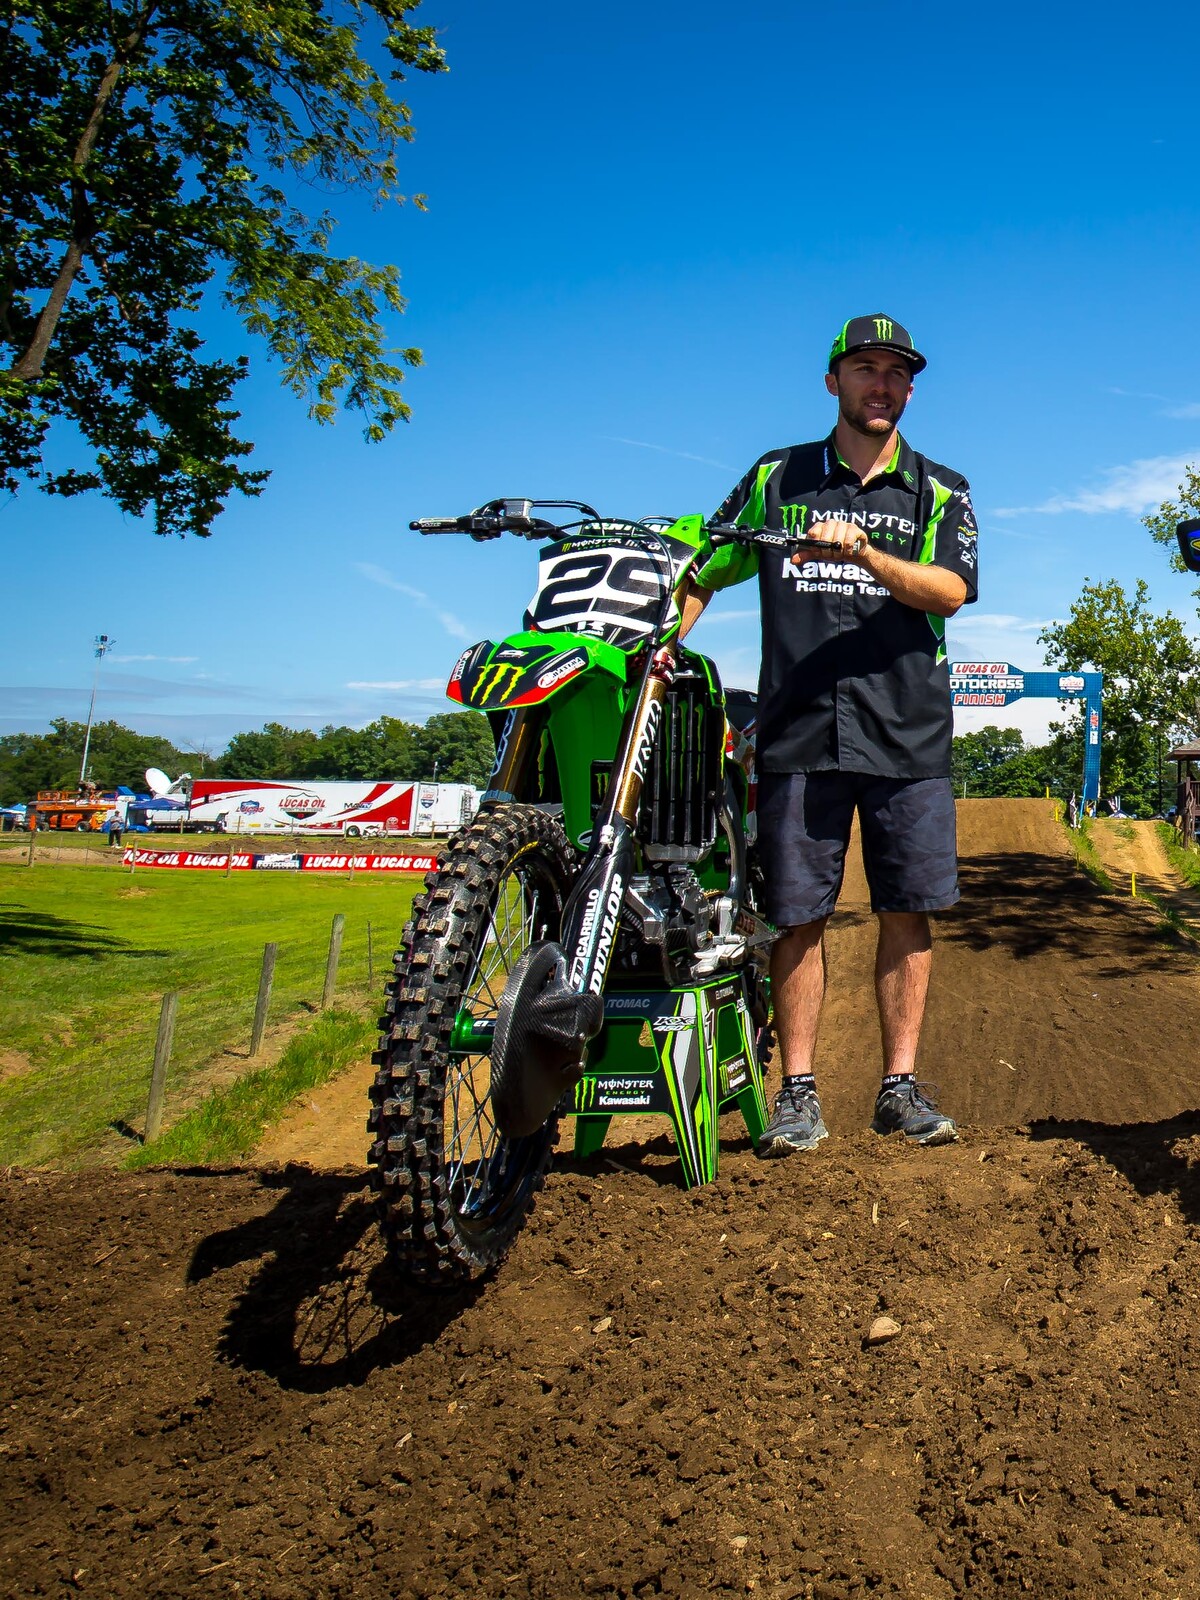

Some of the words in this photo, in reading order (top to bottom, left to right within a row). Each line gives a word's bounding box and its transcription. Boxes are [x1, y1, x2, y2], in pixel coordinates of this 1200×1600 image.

[571, 538, 622, 548] MONSTER
[782, 558, 876, 583] Kawas
[796, 580, 854, 596] Racing
[955, 664, 988, 674] LUCAS
[990, 664, 1006, 674] OIL
[949, 679, 1025, 689] OTOCROSS
[953, 693, 1006, 705] FINISH
[278, 799, 310, 808] LUCAS
[311, 799, 326, 808] OIL
[122, 849, 154, 864] UCAS
[157, 851, 180, 866] OIL
[184, 854, 229, 868] LUCAS
[230, 854, 250, 867] OIL
[305, 856, 347, 868] LUCAS
[348, 856, 368, 868] OIL
[372, 857, 413, 868] LUCAS
[413, 858, 432, 869] OIL
[576, 888, 601, 958] CARRILLO
[589, 873, 624, 996] DUNLOP
[597, 1078, 655, 1091] MONSTER
[598, 1095, 651, 1106] Kawasaki
